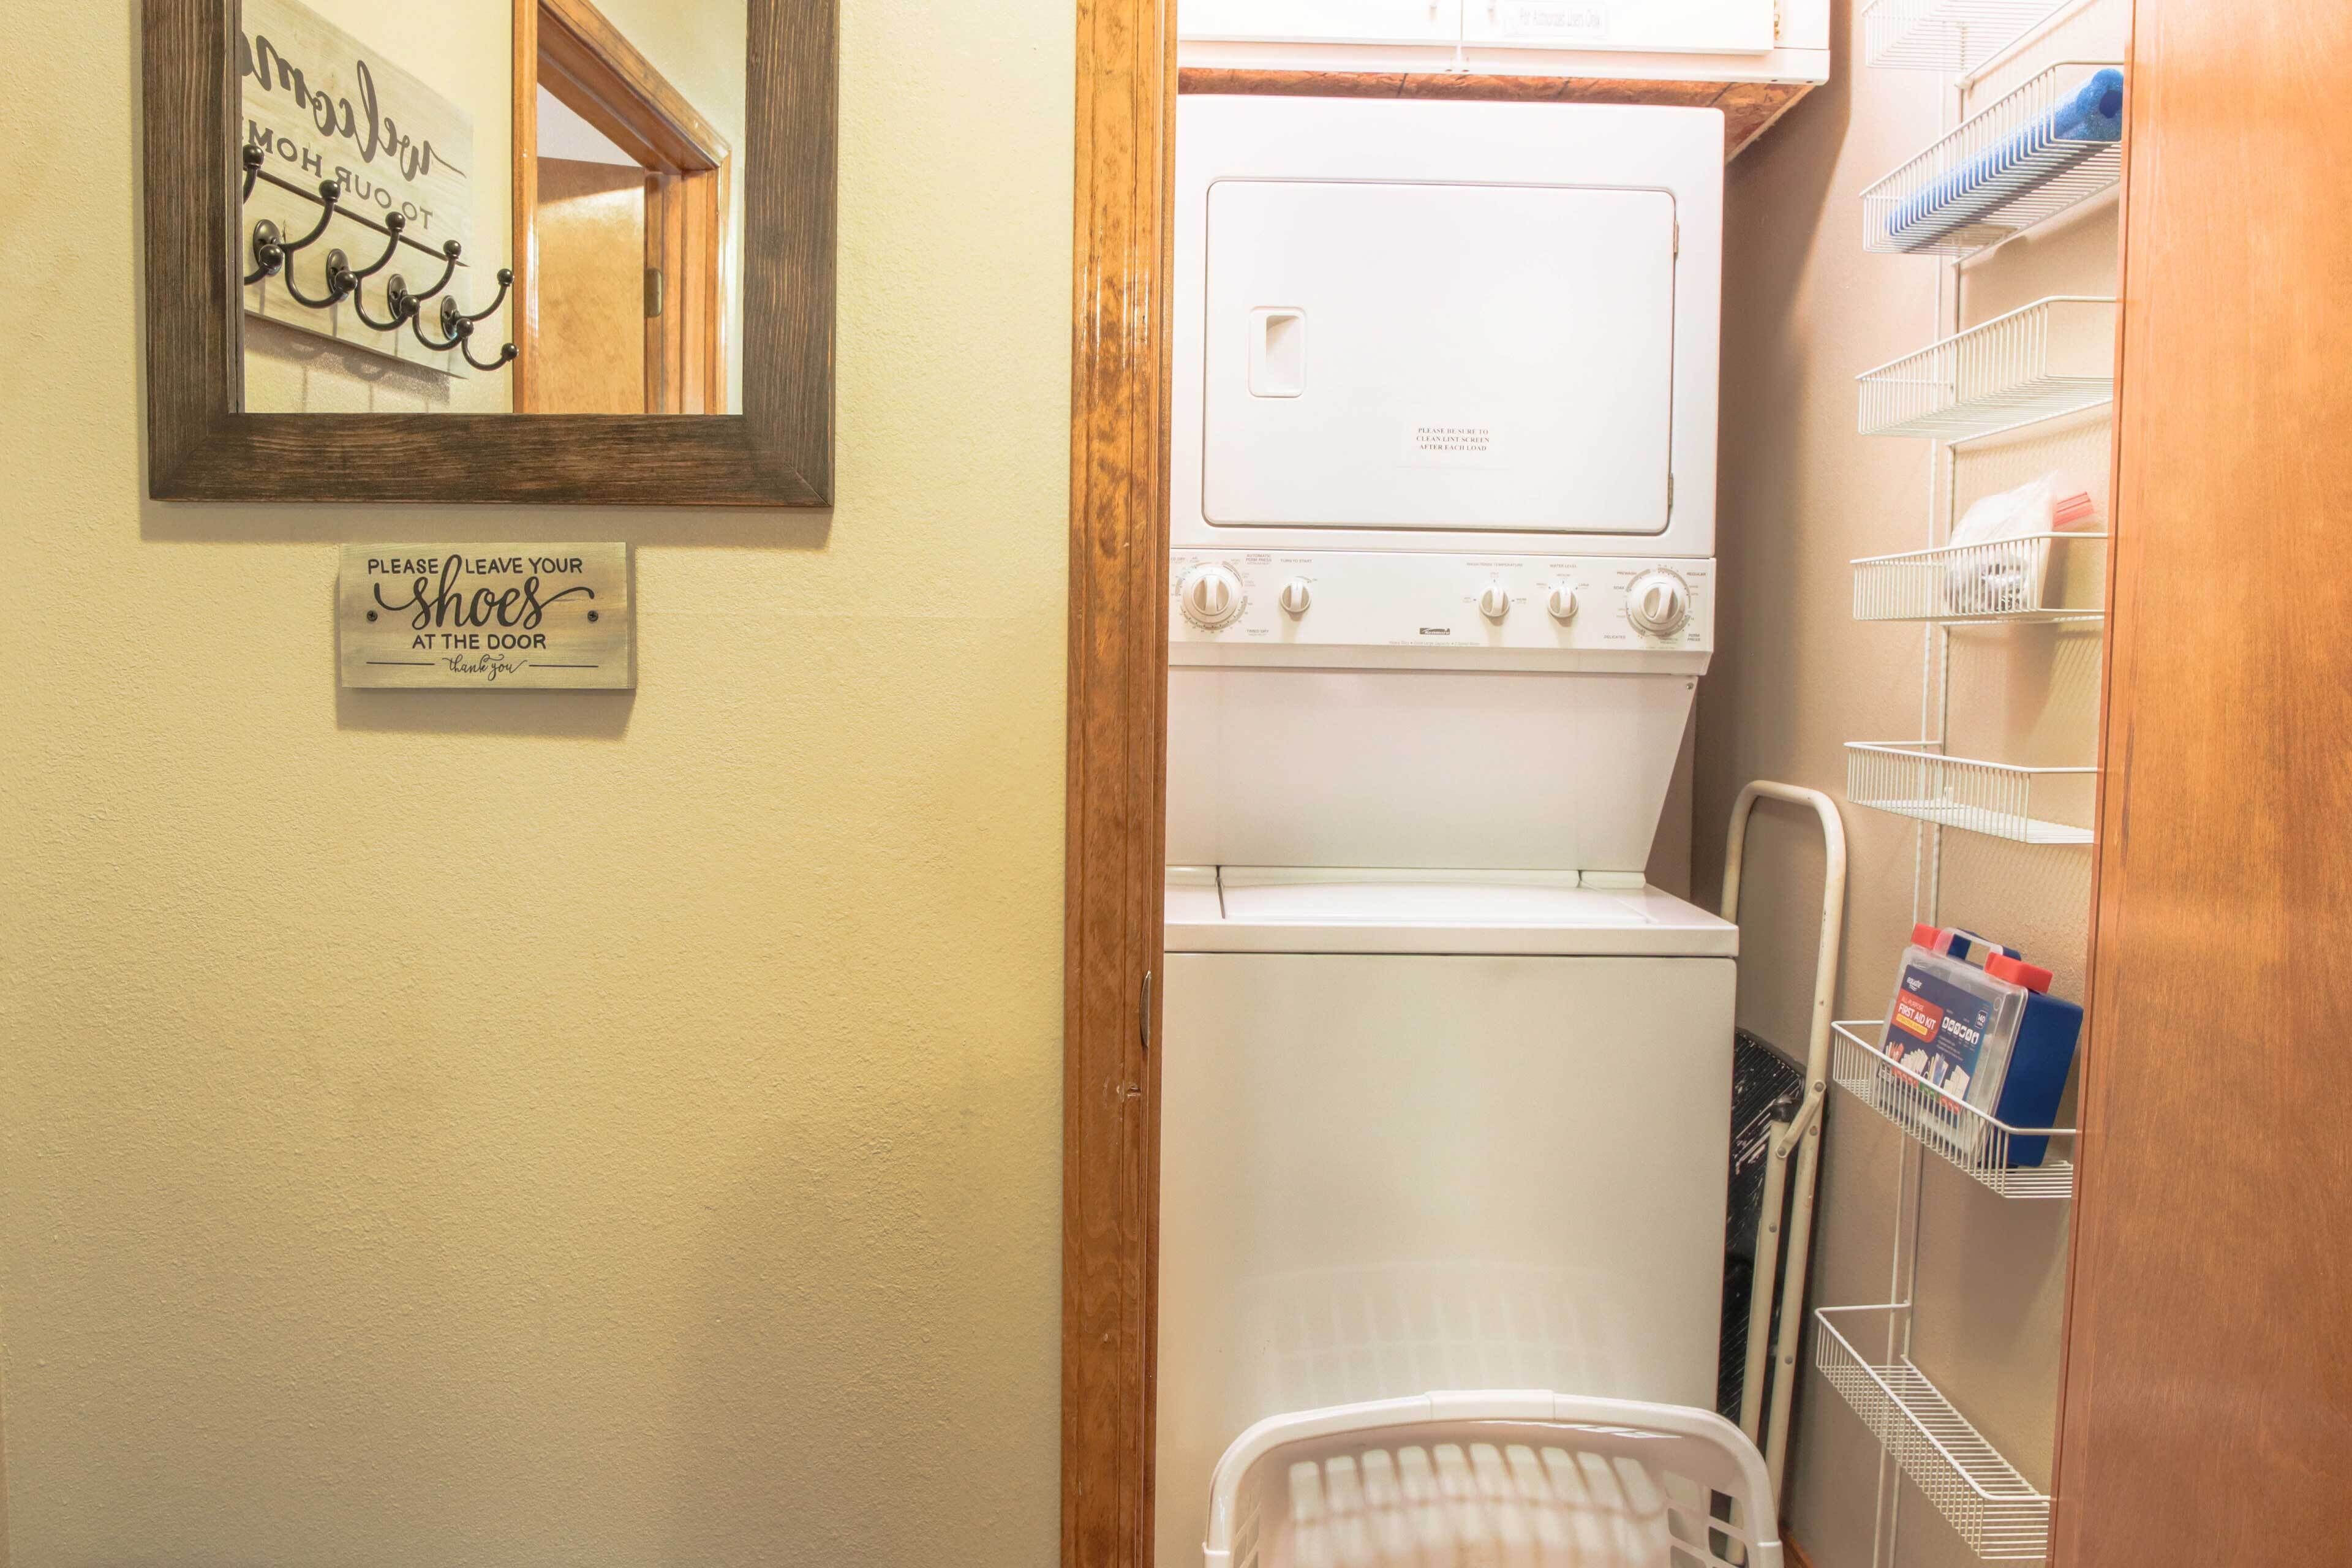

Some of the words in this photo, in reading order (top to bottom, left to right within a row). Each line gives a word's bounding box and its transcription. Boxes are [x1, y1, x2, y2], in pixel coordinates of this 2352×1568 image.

[368, 558, 439, 575] PLEASE
[466, 557, 523, 574] LEAVE
[529, 557, 583, 574] YOUR
[374, 554, 595, 630] shoes
[412, 634, 436, 649] AT
[441, 634, 480, 649] THE
[488, 634, 546, 650] DOOR
[442, 654, 504, 674] thank
[487, 659, 527, 681] you
[1898, 1003, 1915, 1019] FIRST
[1913, 1011, 1926, 1025] AID
[1924, 1017, 1937, 1030] KIT
